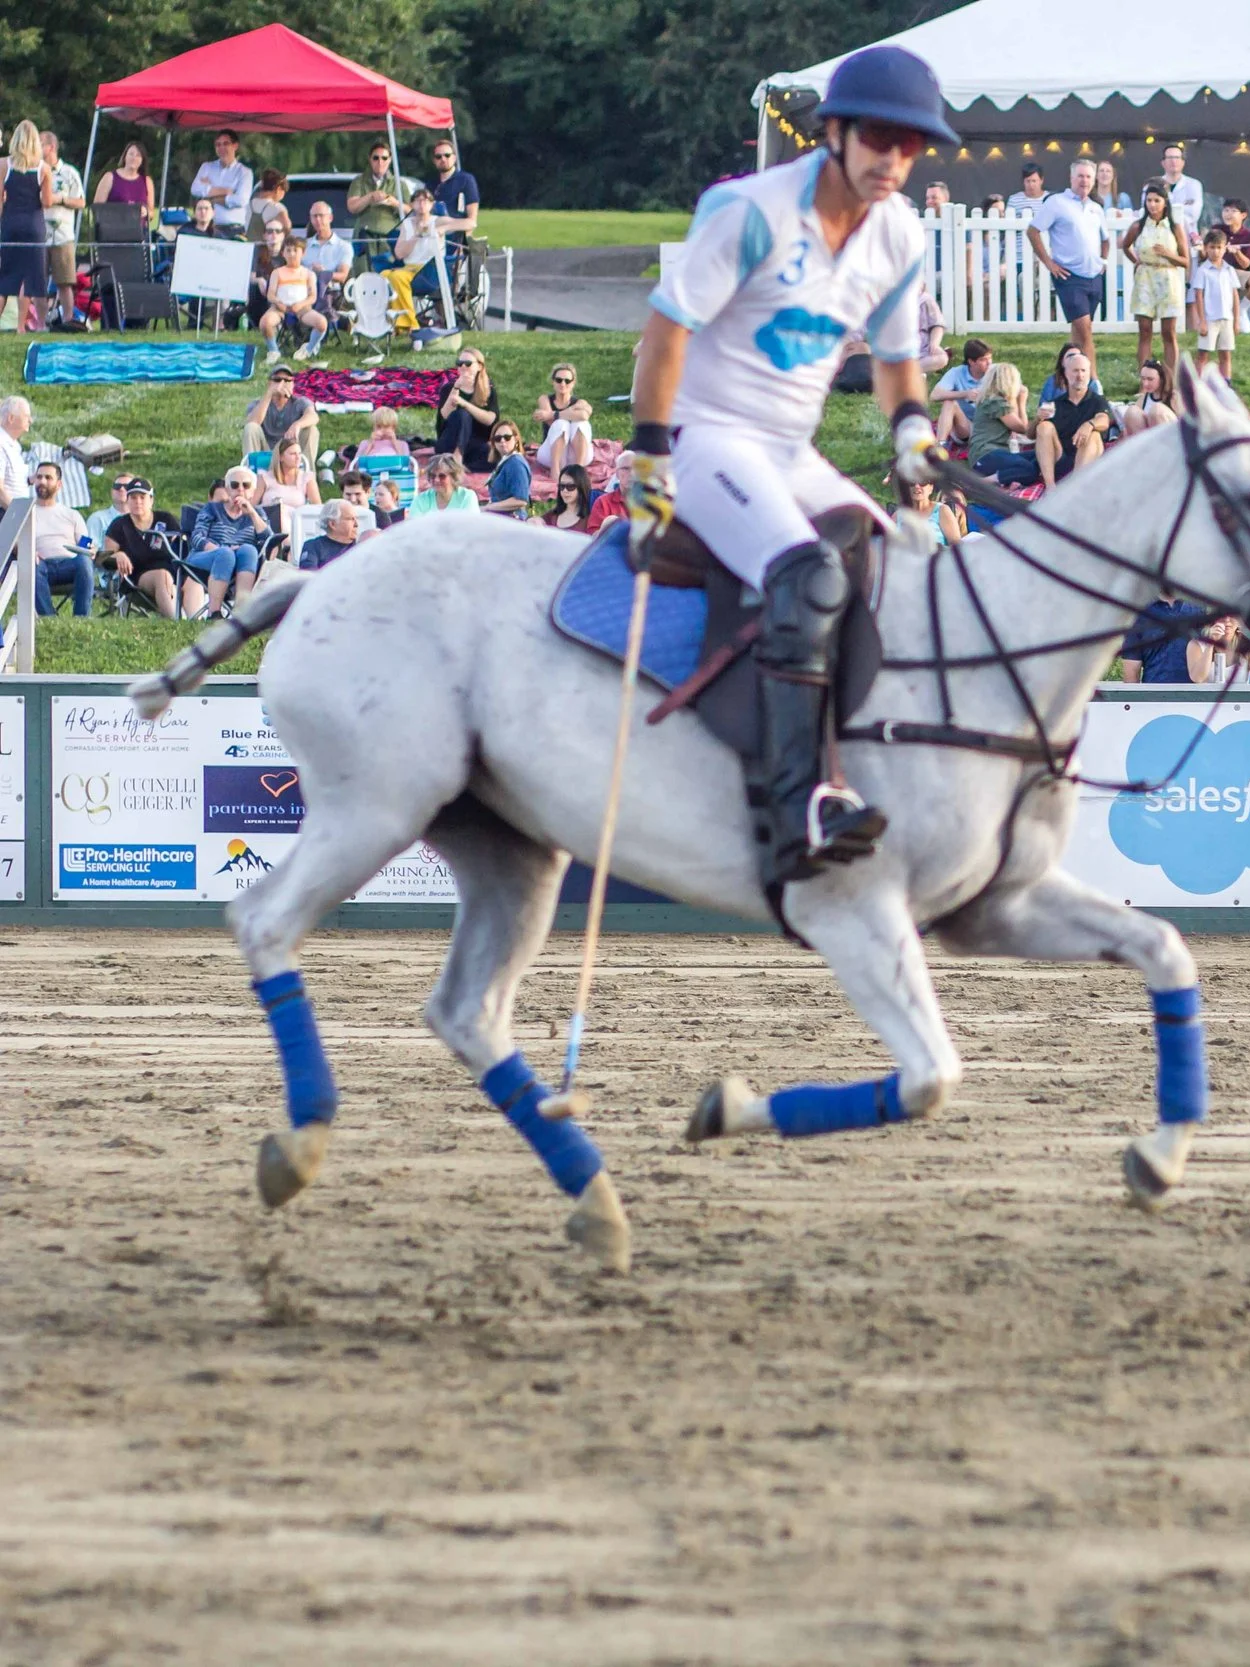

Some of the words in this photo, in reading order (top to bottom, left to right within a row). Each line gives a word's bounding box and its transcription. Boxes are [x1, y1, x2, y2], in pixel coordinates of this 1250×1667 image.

[777, 240, 809, 286] 3
[160, 709, 190, 729] Care
[96, 735, 158, 743] SERVICES
[221, 729, 252, 739] Blue
[224, 745, 249, 758] 45
[252, 751, 289, 759] CARING
[123, 777, 197, 793] CUCINELLI
[208, 802, 286, 818] partners
[290, 802, 306, 815] in
[86, 847, 195, 863] Pro-Healthcare
[86, 862, 134, 873] SERVICING
[135, 862, 151, 873] LLC
[376, 867, 429, 878] SPRING
[82, 878, 88, 886] A
[89, 878, 110, 887] Home
[111, 878, 150, 887] Healthcare
[150, 878, 177, 888] Agency
[365, 890, 391, 898] Leading
